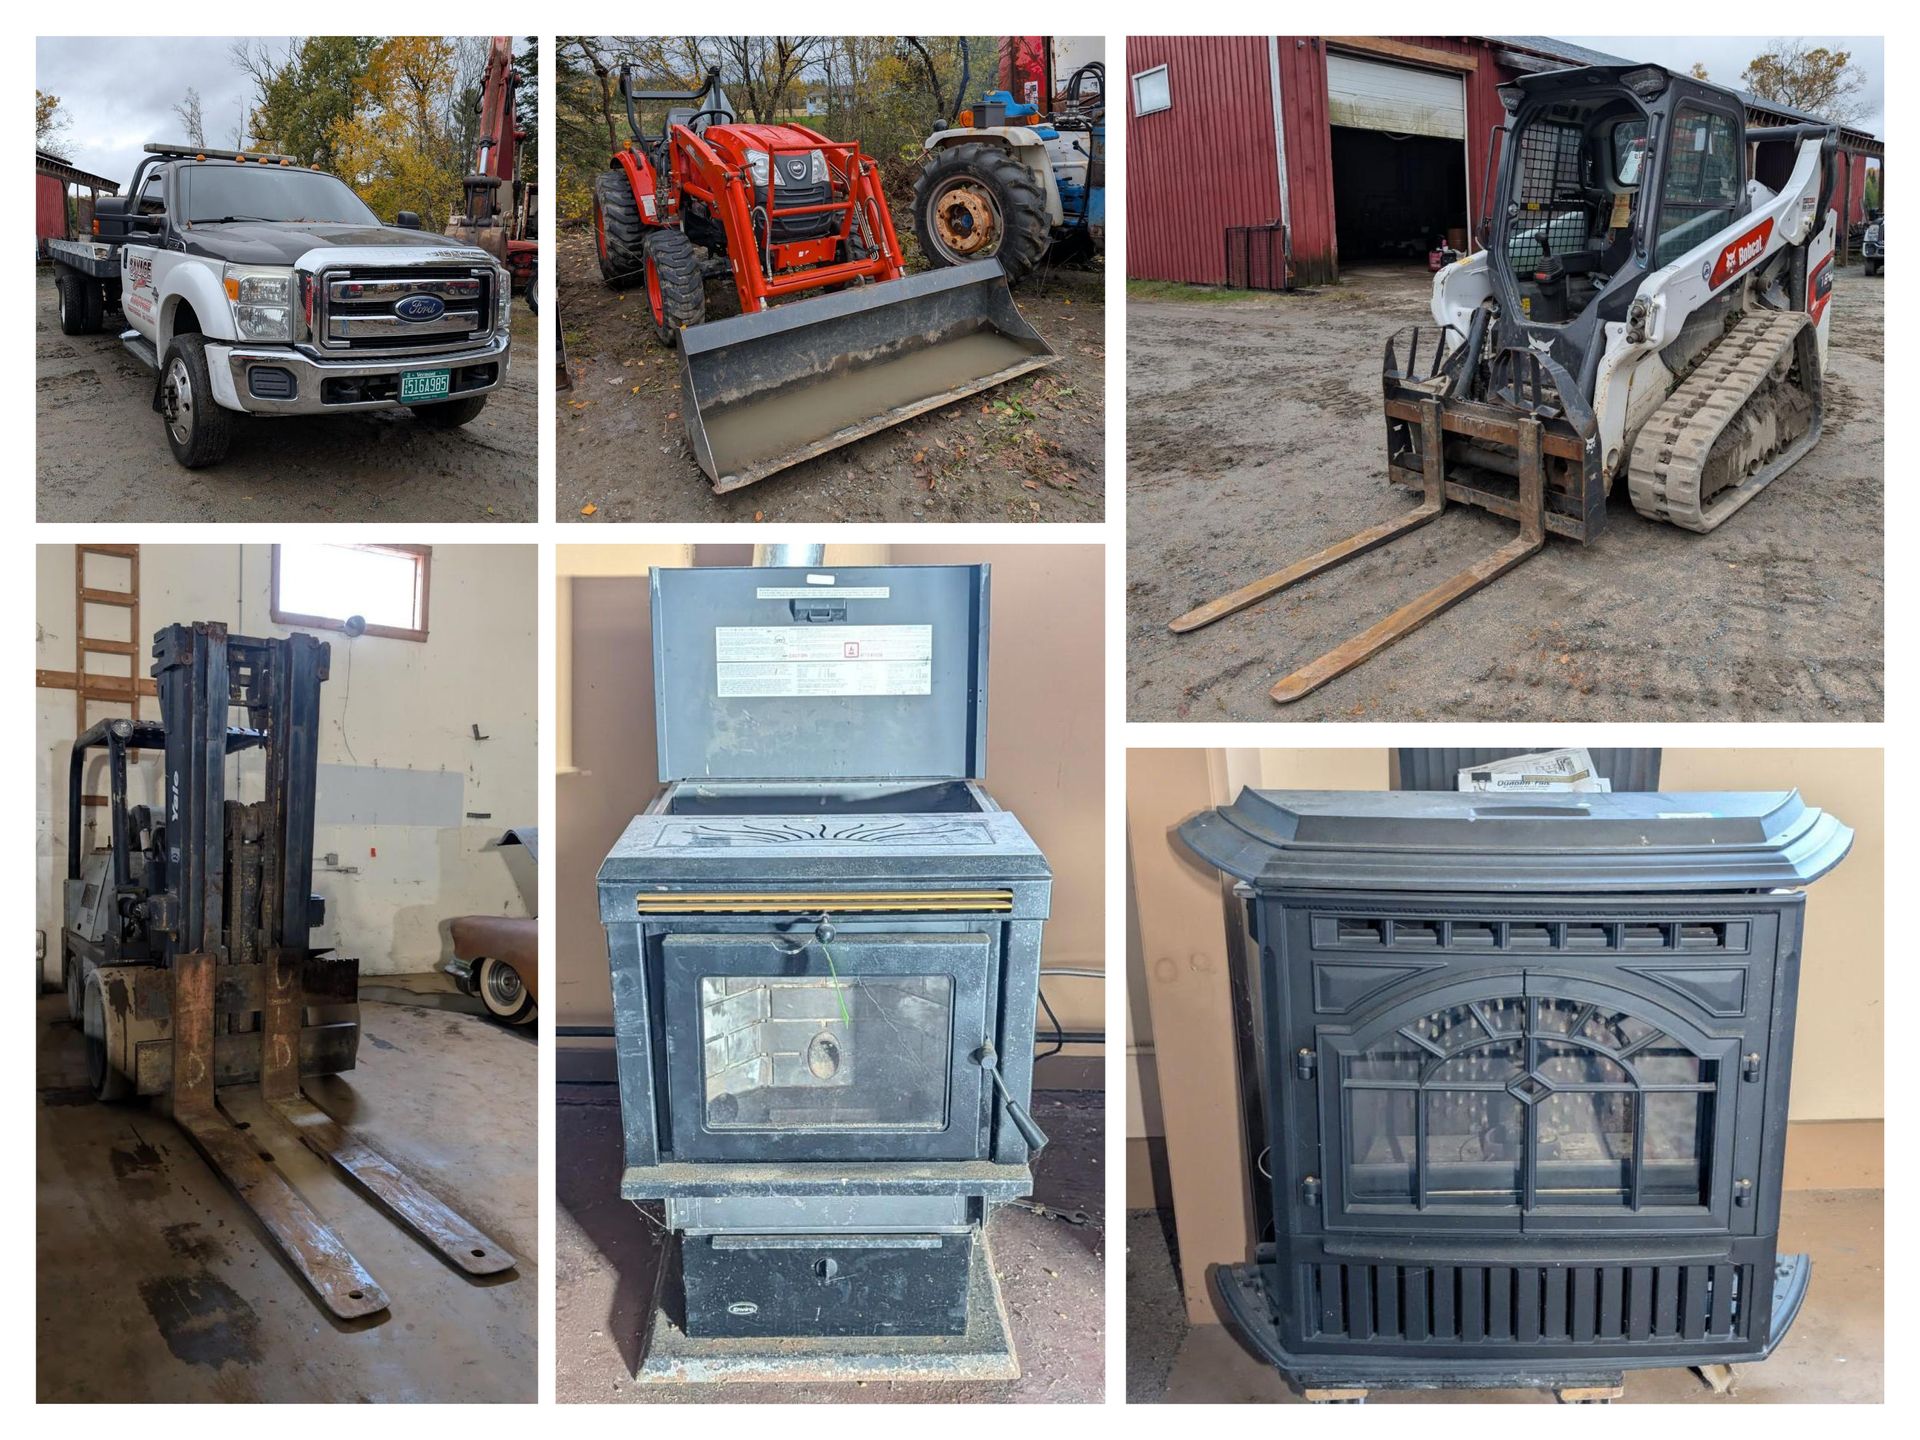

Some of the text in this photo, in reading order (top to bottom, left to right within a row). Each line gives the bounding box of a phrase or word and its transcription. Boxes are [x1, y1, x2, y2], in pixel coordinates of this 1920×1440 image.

[1738, 234, 1763, 266] Bobcat
[408, 300, 436, 314] Ford
[408, 376, 447, 394] 516A985
